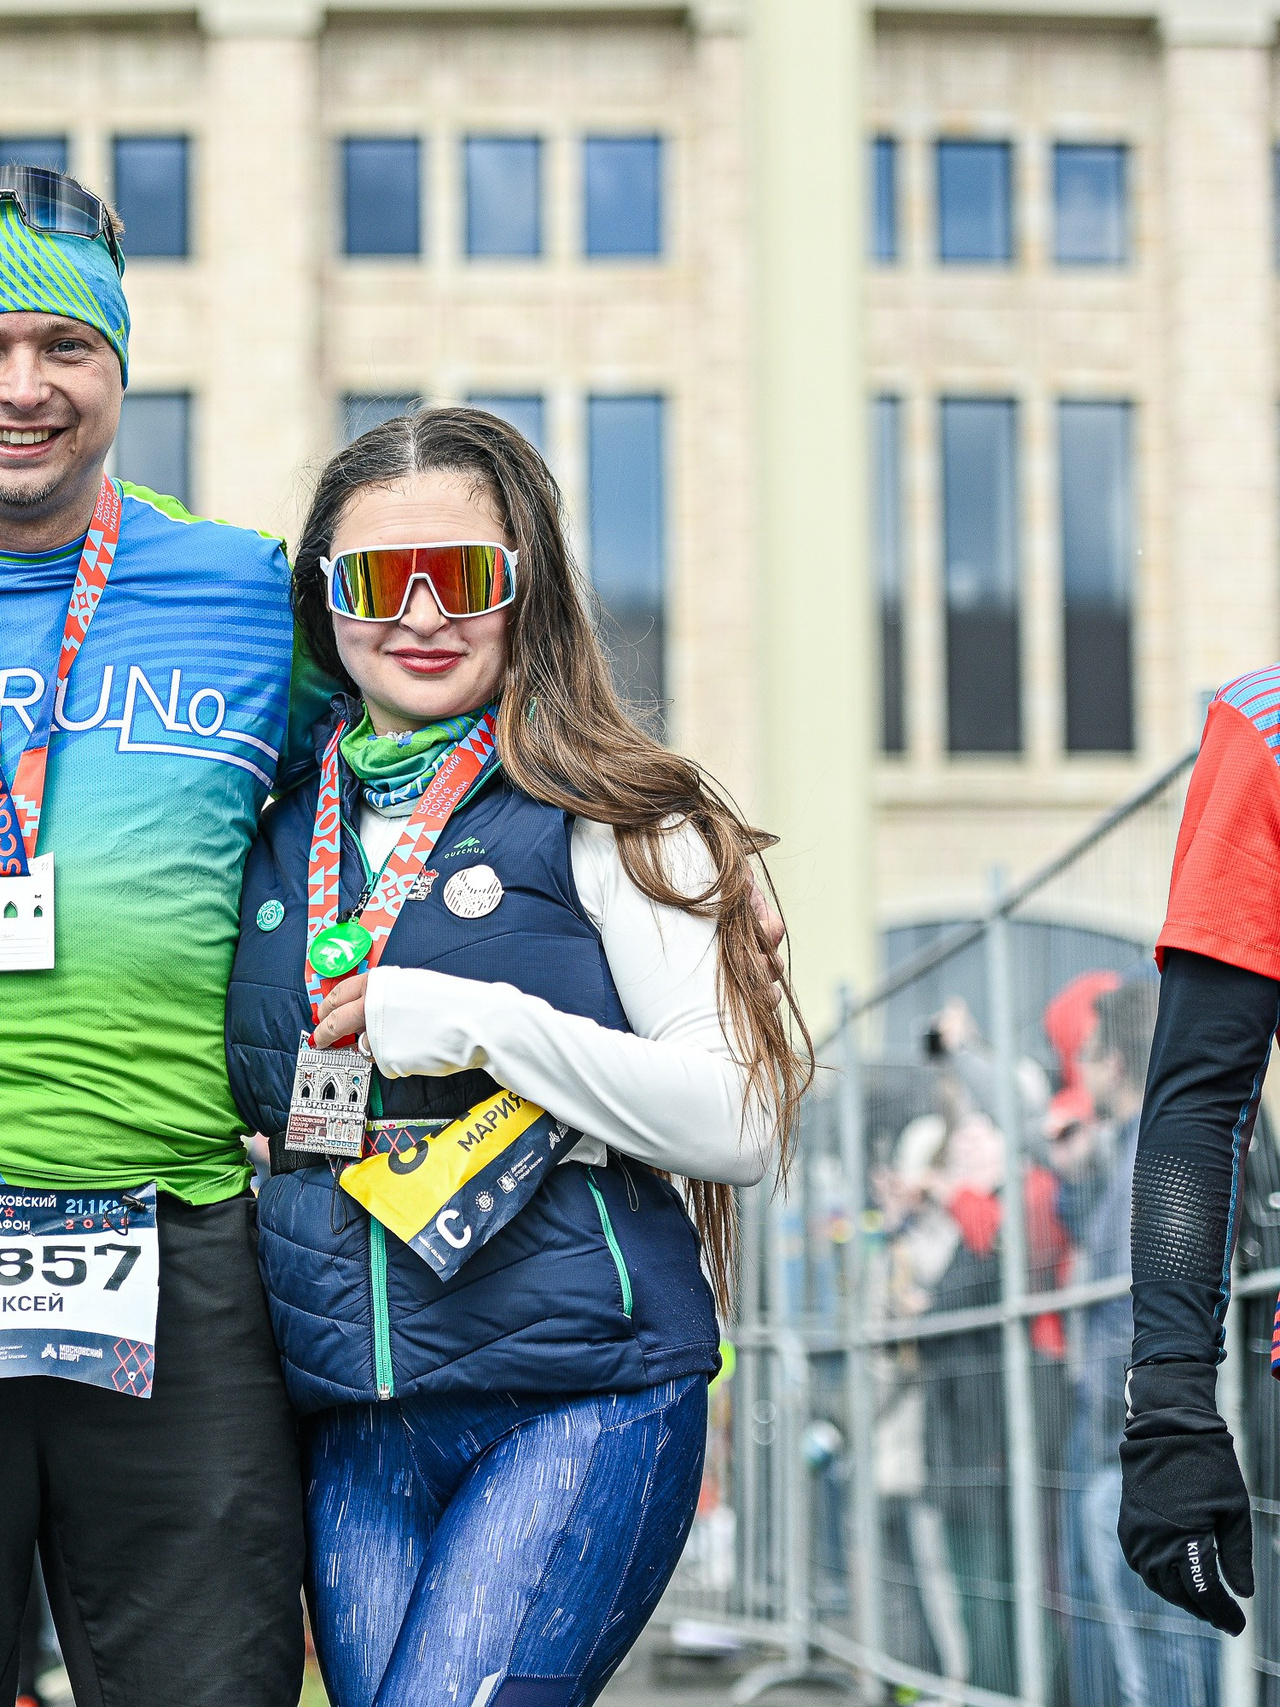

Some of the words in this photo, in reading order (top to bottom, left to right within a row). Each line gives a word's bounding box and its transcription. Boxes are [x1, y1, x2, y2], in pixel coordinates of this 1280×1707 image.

[416, 753, 462, 815] МОСКОВСКИЙ
[427, 792, 447, 817] ПОЛУ
[436, 780, 470, 820] МАРАФОН
[457, 1090, 529, 1153] МАРИЯ
[436, 1209, 472, 1249] C
[1187, 1540, 1208, 1593] KIPRUN
